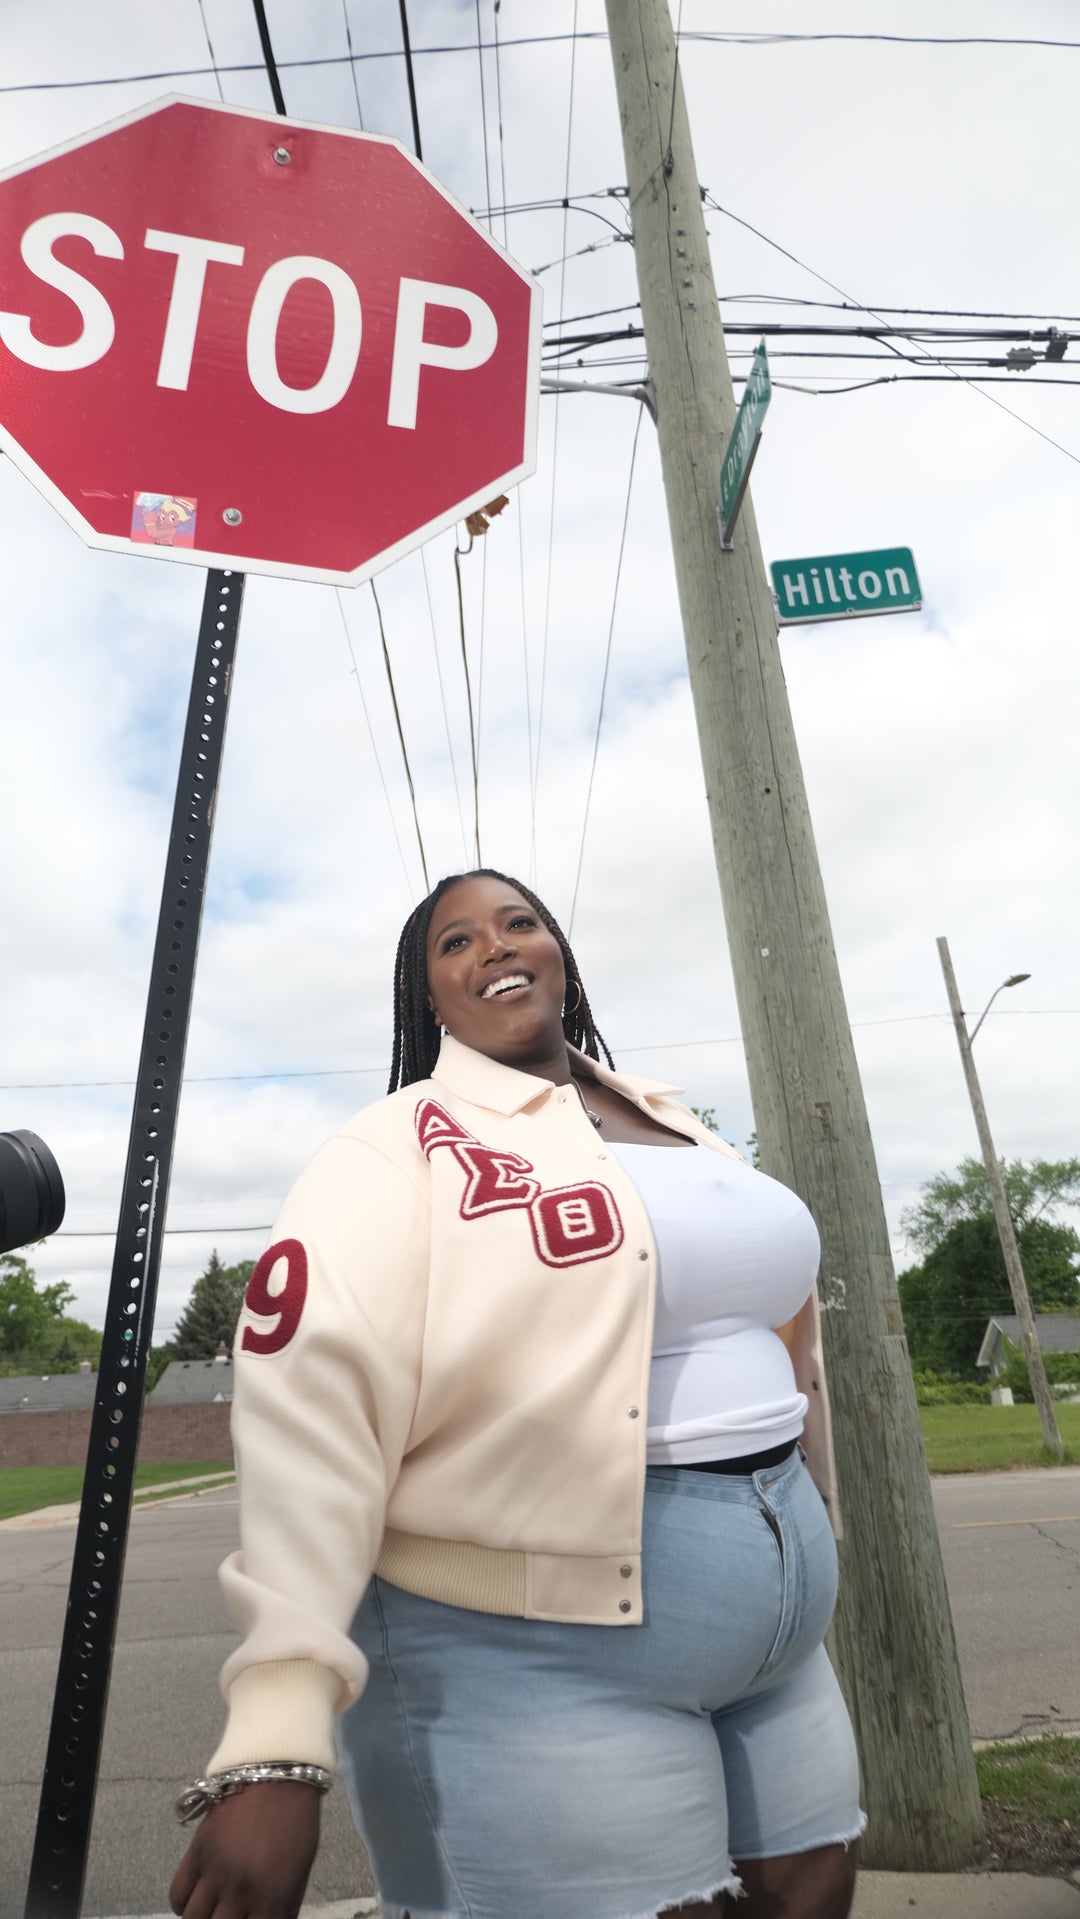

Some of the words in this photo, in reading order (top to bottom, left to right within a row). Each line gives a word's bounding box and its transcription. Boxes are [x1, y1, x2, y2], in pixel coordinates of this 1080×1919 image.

[0, 212, 499, 430] STOP
[782, 566, 911, 608] Hilton
[242, 1238, 309, 1355] 9
